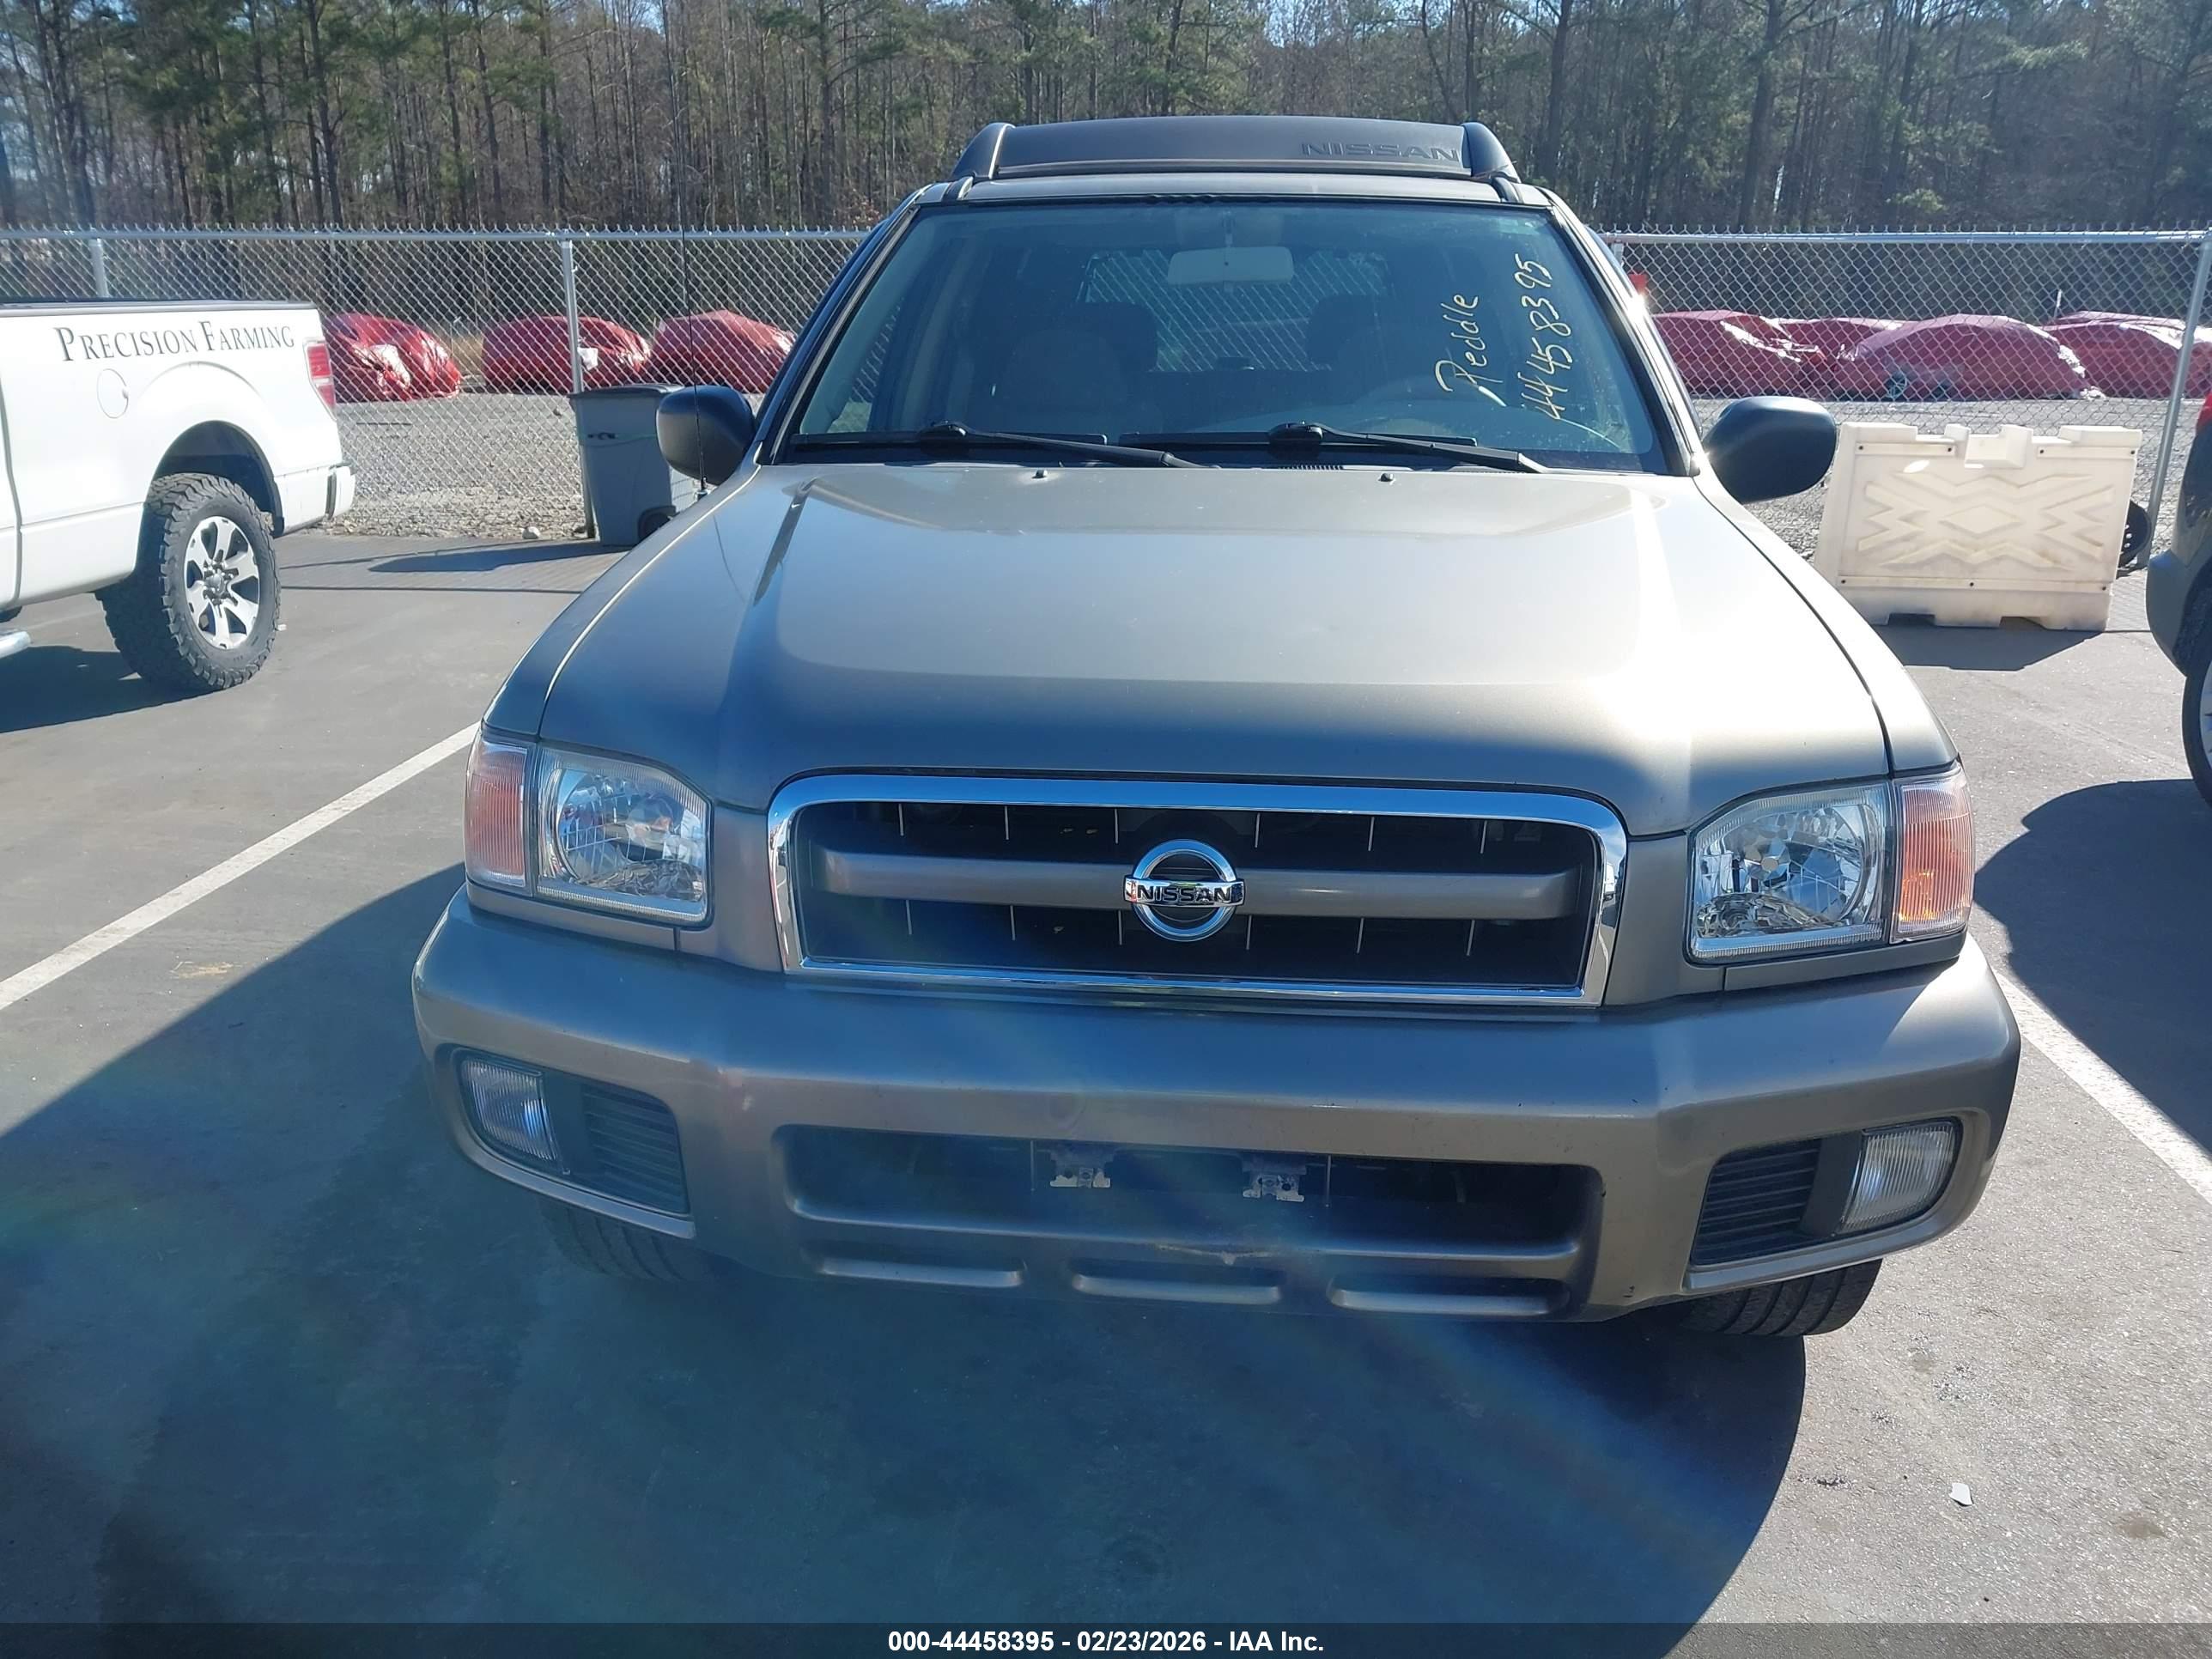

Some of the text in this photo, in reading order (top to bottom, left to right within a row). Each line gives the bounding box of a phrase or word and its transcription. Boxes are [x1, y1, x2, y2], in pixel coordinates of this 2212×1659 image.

[1300, 142, 1461, 162] NISSAN
[1434, 294, 1506, 407] Peddle
[1515, 253, 1573, 421] 44458395
[1137, 884, 1231, 902] NISSAN
